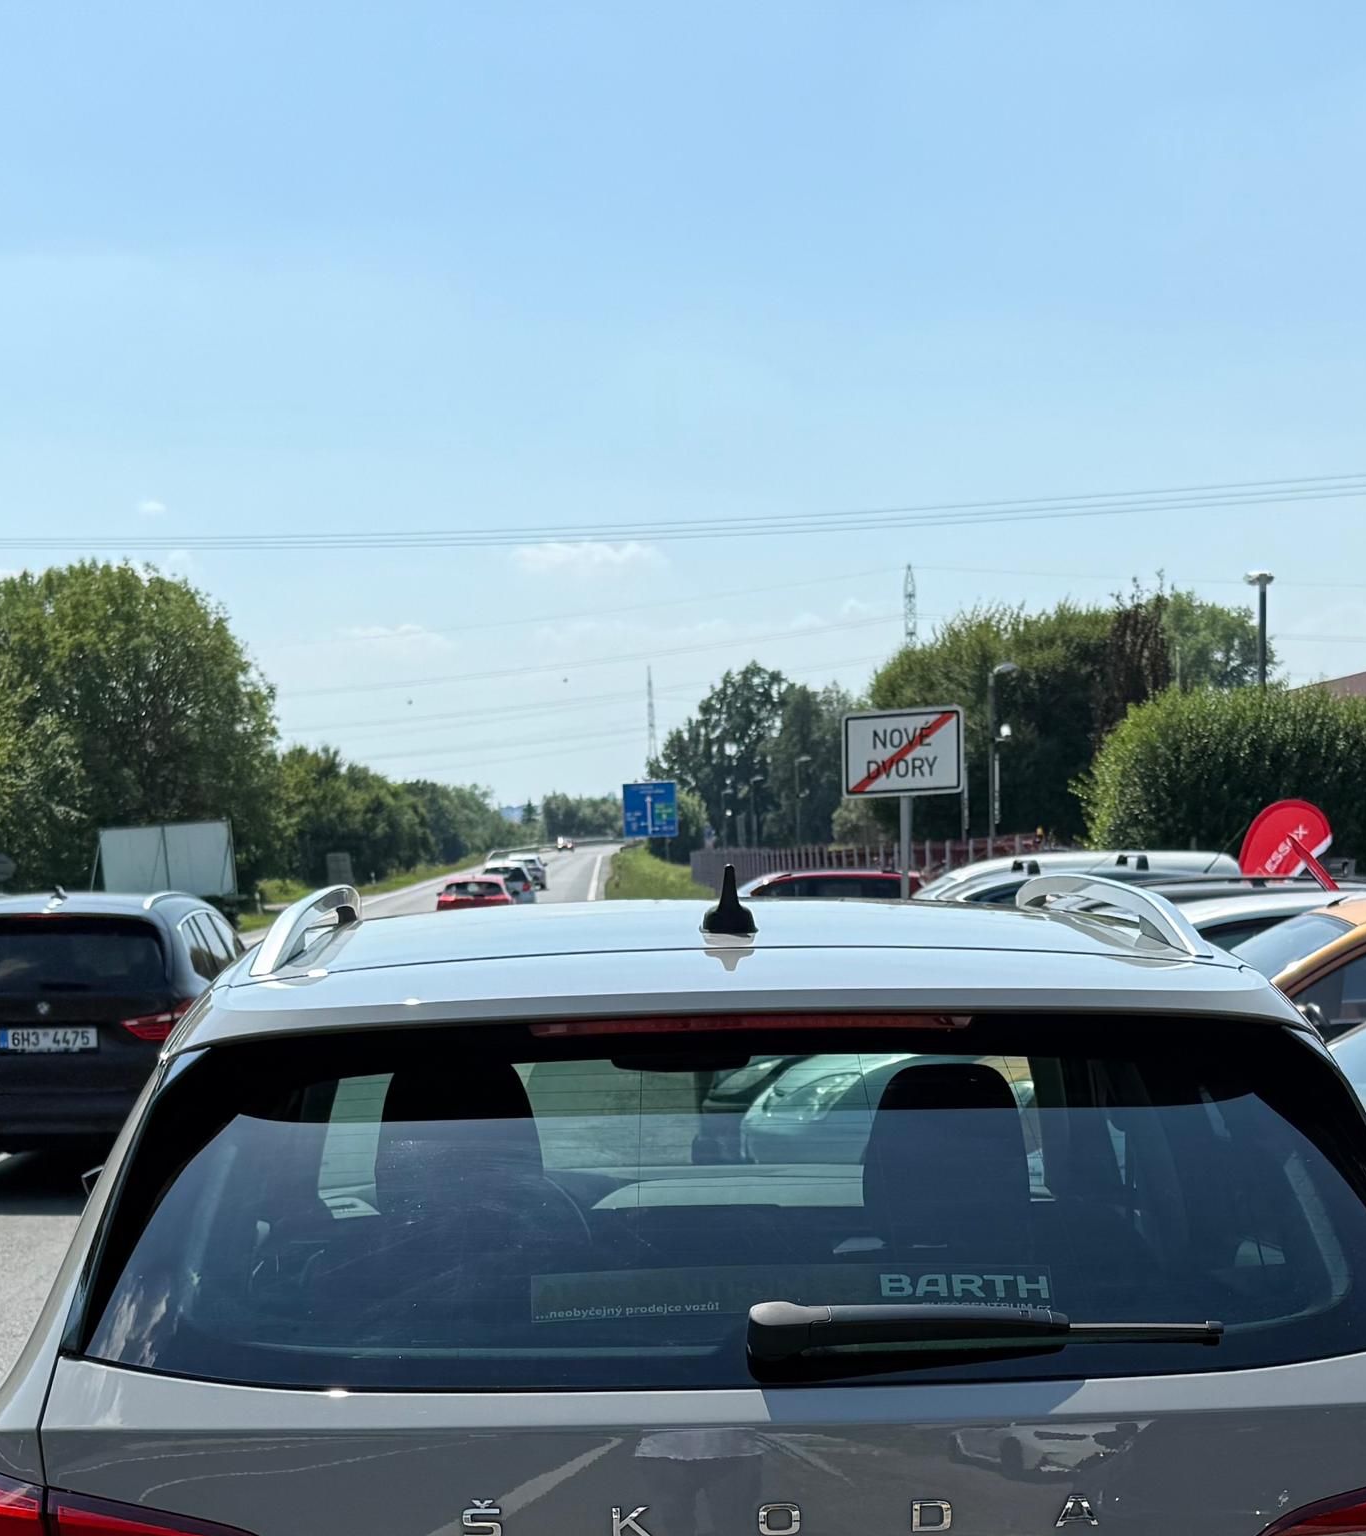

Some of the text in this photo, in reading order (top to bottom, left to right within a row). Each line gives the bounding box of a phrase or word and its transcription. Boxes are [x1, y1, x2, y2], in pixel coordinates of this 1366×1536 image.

[872, 721, 932, 750] NOVÉ
[866, 756, 938, 779] DVORY
[11, 1030, 91, 1048] 6H3 4475
[879, 1273, 1051, 1299] BARTH
[625, 1303, 682, 1317] prodejce
